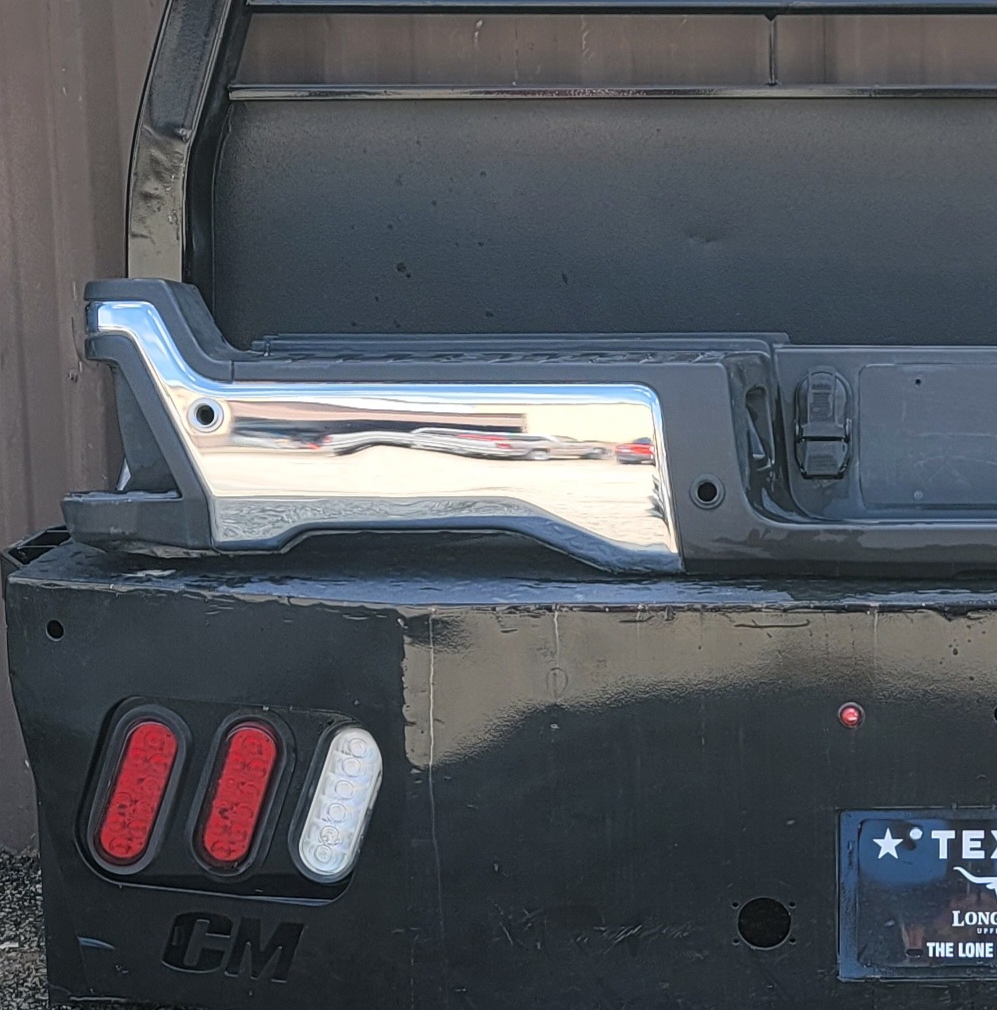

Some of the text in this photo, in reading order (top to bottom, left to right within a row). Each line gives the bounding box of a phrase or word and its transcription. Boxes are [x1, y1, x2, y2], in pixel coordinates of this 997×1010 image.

[160, 912, 305, 983] CM
[927, 942, 954, 958] THE
[958, 942, 994, 958] LONE
